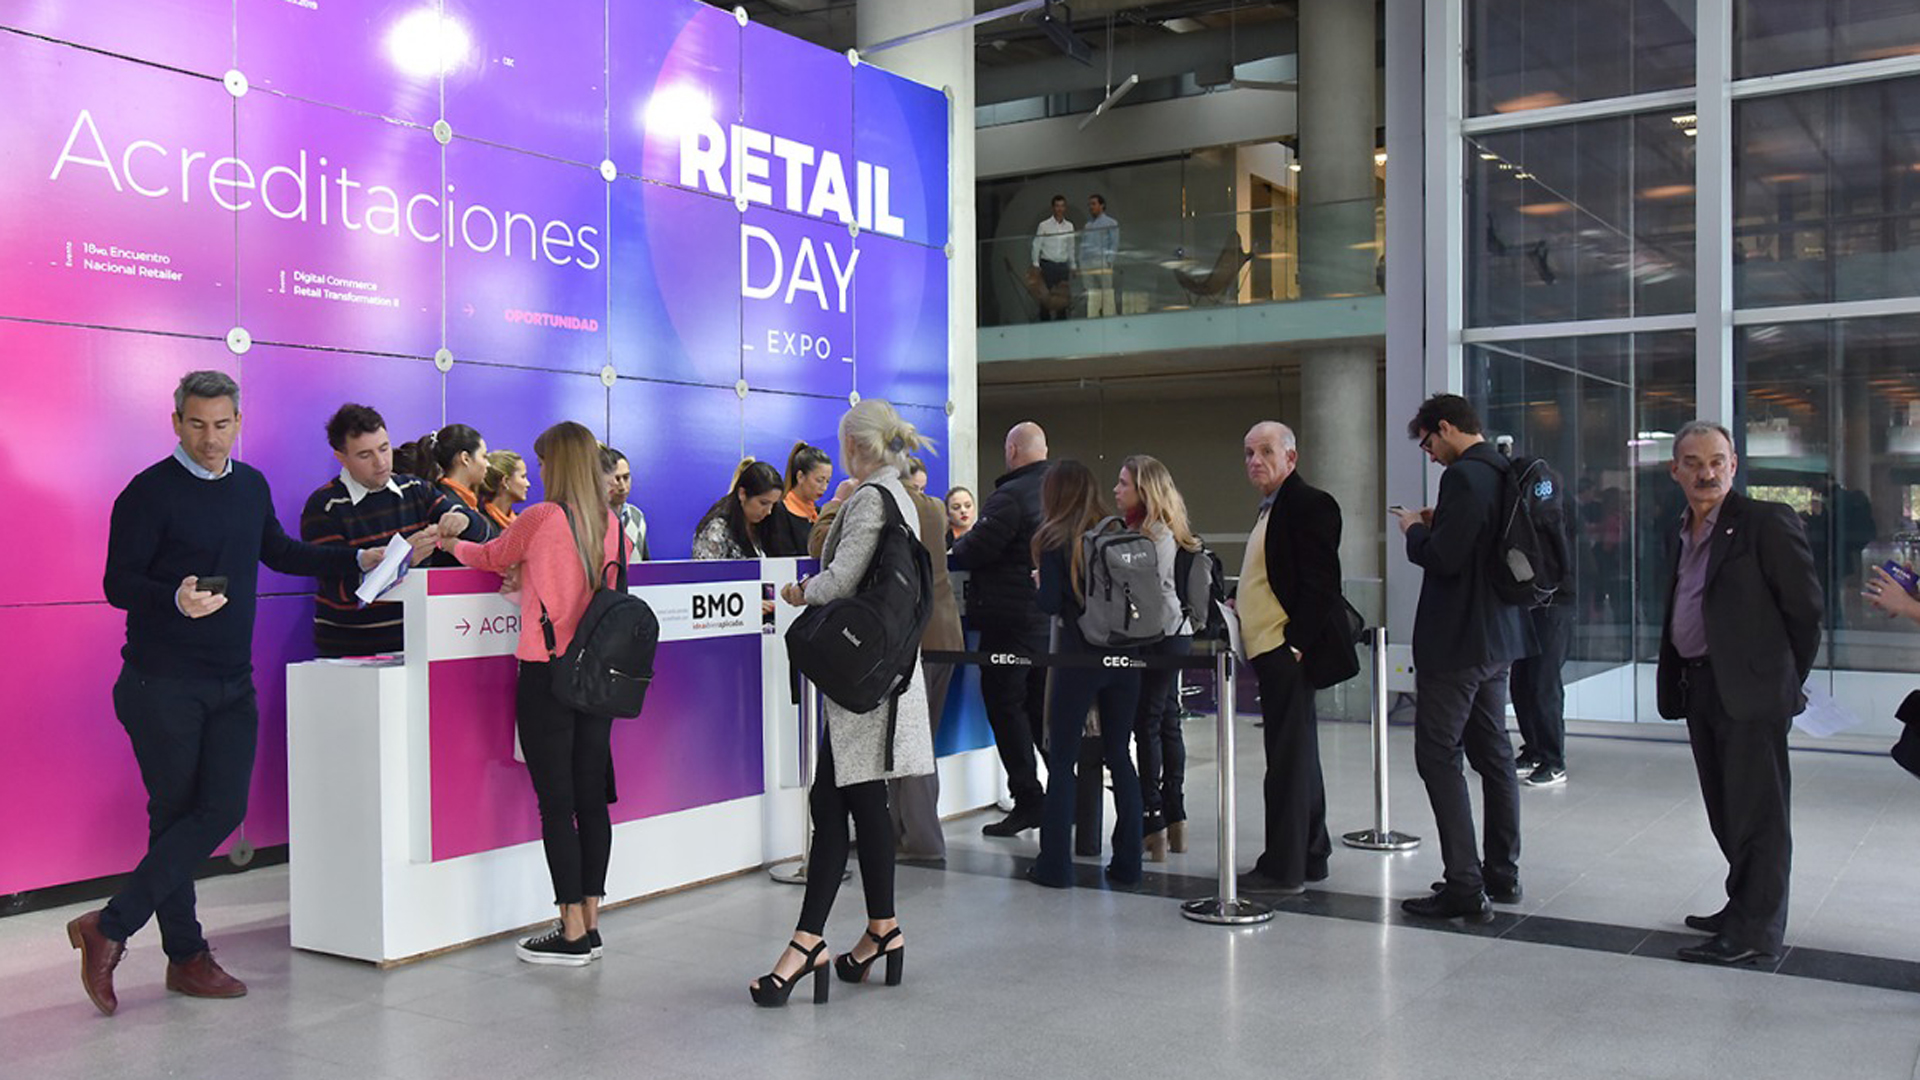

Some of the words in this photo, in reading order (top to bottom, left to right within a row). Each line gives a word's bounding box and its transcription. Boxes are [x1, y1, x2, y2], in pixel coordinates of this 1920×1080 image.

[49, 108, 601, 270] Acreditaciones
[679, 123, 905, 238] RETAIL
[110, 245, 171, 265] Encuentro
[83, 259, 137, 275] Nacional
[138, 265, 183, 281] Retailer
[293, 270, 325, 284] Digital
[326, 275, 378, 291] Commerce
[741, 225, 860, 313] DAY
[293, 285, 322, 298] Retail
[504, 309, 599, 332] OPORTUNIDAD
[766, 329, 831, 360] EXPO
[692, 592, 744, 619] BMO
